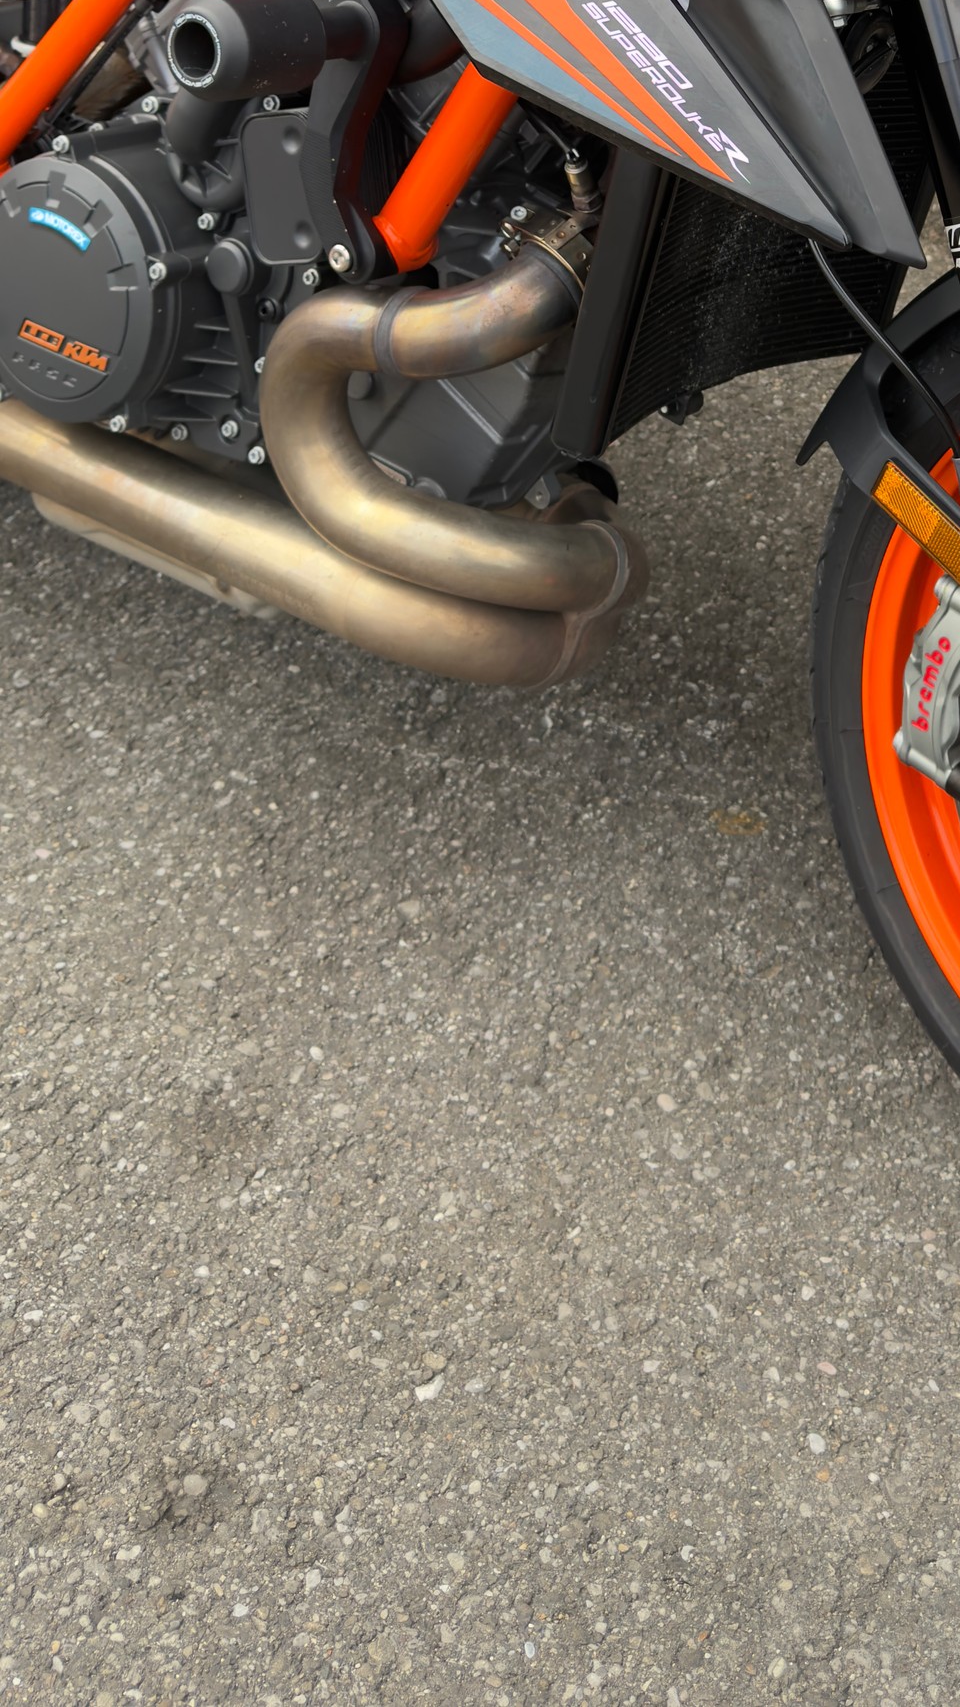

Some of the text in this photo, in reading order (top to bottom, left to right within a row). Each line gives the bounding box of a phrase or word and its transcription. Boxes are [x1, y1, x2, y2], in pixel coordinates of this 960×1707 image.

[602, 0, 694, 90] 1290
[581, 1, 751, 184] SUPERDUKE R
[44, 212, 86, 247] MOTOREX
[62, 340, 110, 373] KTM
[911, 636, 951, 733] brembo
